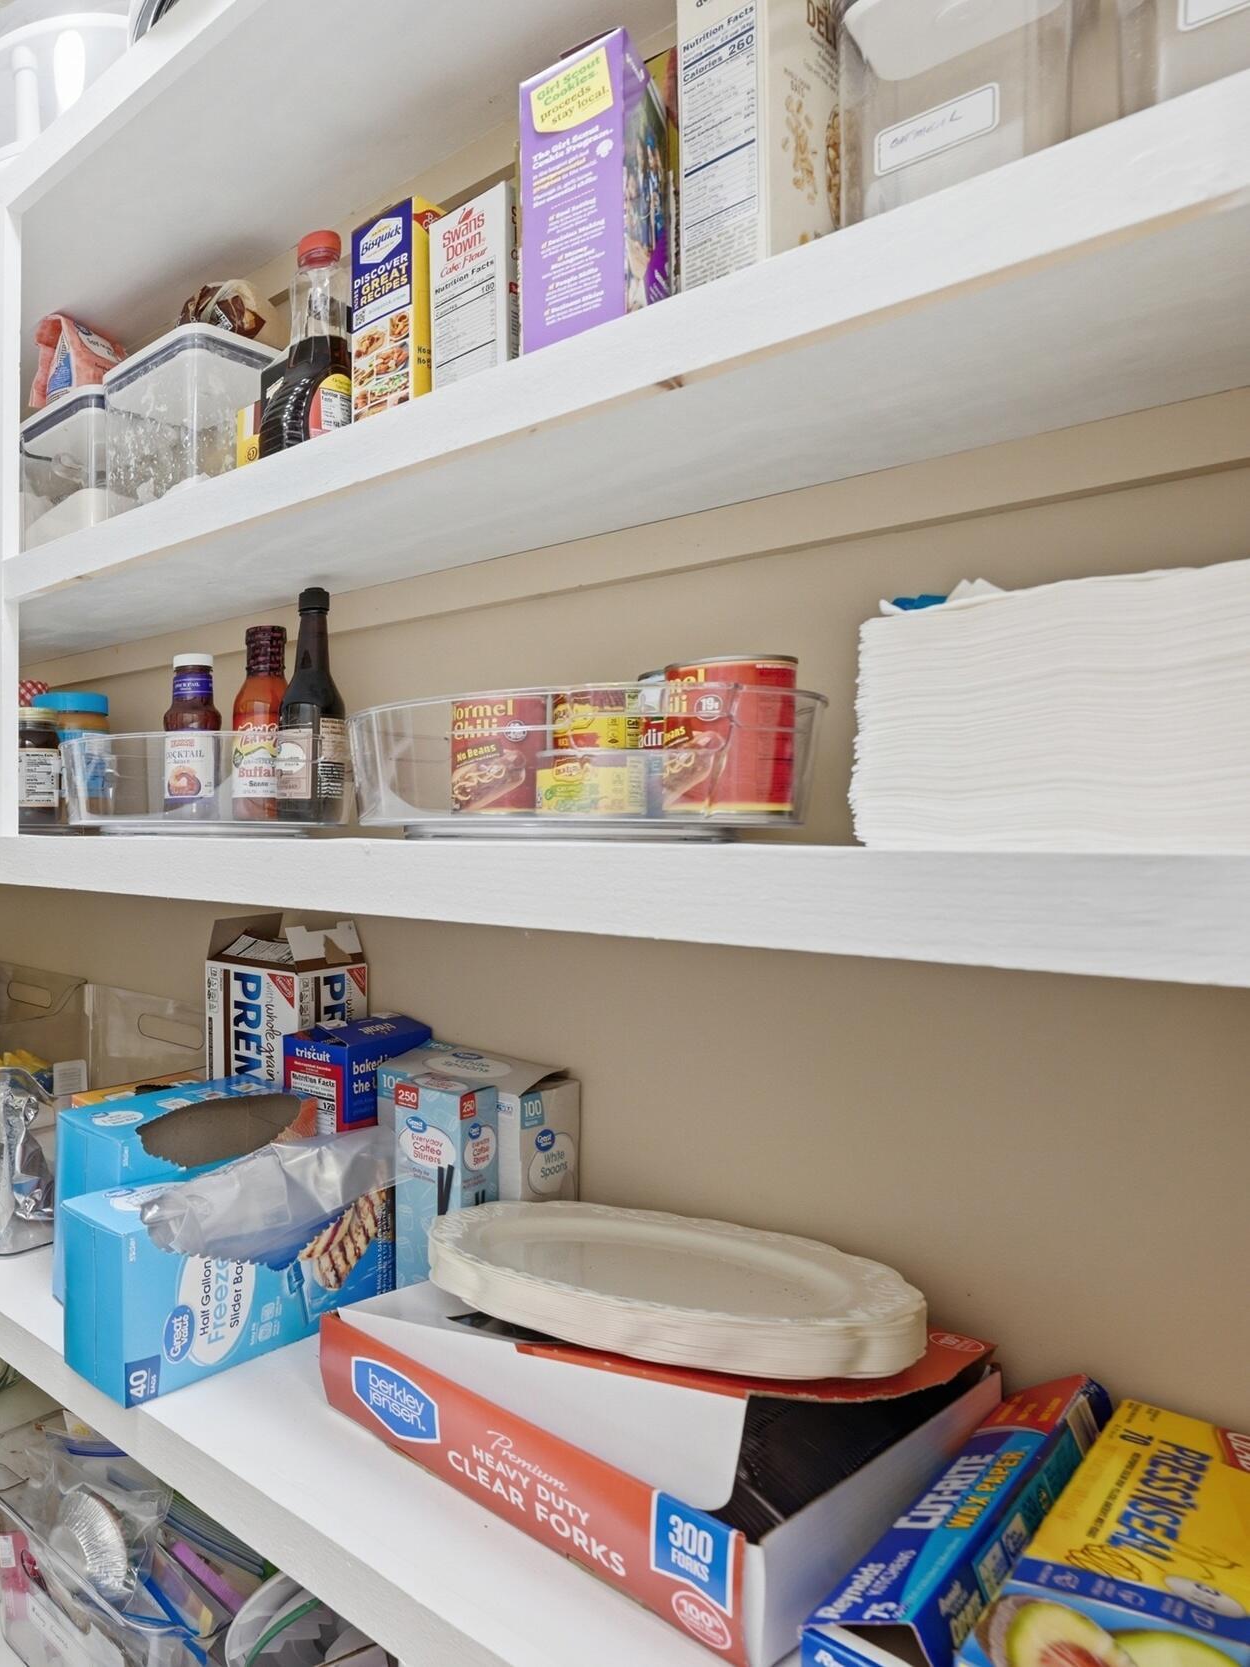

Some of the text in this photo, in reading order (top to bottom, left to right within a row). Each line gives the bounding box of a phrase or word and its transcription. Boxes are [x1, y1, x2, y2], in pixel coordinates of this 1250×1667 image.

[683, 6, 754, 53] Nutrition Facts
[683, 34, 754, 82] Calories 260
[536, 80, 560, 101] Girl
[563, 57, 601, 85] Scout
[539, 85, 592, 123] proceeds
[551, 106, 574, 125] stay
[360, 224, 402, 257] Bisquick
[441, 211, 486, 249] Swans
[445, 231, 483, 263] Down
[353, 252, 409, 289] DISCOVER
[361, 261, 409, 296] GREAT
[434, 260, 495, 295] Nutrition Facts
[439, 246, 488, 279] Cake Flour
[360, 274, 408, 307] RECIPES
[453, 718, 498, 740] Chili
[456, 743, 497, 763] No Beans
[265, 1003, 282, 1043] whole
[261, 1041, 280, 1082] grain
[295, 1046, 331, 1063] triscuit
[352, 1080, 371, 1095] the
[397, 1089, 417, 1104] 250
[461, 1101, 475, 1113] 250
[523, 1099, 543, 1117] 100
[411, 1133, 444, 1148] Everyday
[412, 1141, 442, 1156] Coffee
[413, 1151, 442, 1165] Stirrers
[543, 1150, 566, 1165] White
[540, 1161, 568, 1180] Spoons
[199, 1259, 213, 1337] Half Gallon
[207, 1256, 230, 1345] Freeze
[229, 1258, 245, 1329] Slider Ba
[170, 1313, 183, 1359] Great
[180, 1313, 191, 1347] Value
[128, 1368, 148, 1400] 40
[149, 1374, 158, 1396] BAGS
[368, 1366, 425, 1415] berkley
[1117, 1427, 1155, 1455] 70
[487, 1430, 569, 1494] Premium
[471, 1444, 591, 1528] HEAVY DUTY
[945, 1488, 990, 1530] WAX
[976, 1449, 1027, 1497] PAPER
[447, 1449, 627, 1578] CLEAR FORKS
[667, 1514, 714, 1565] 300
[670, 1547, 710, 1583] FORKS
[864, 1548, 917, 1597] KITCHENS
[815, 1561, 887, 1621] Reynolds
[862, 1601, 900, 1623] 75
